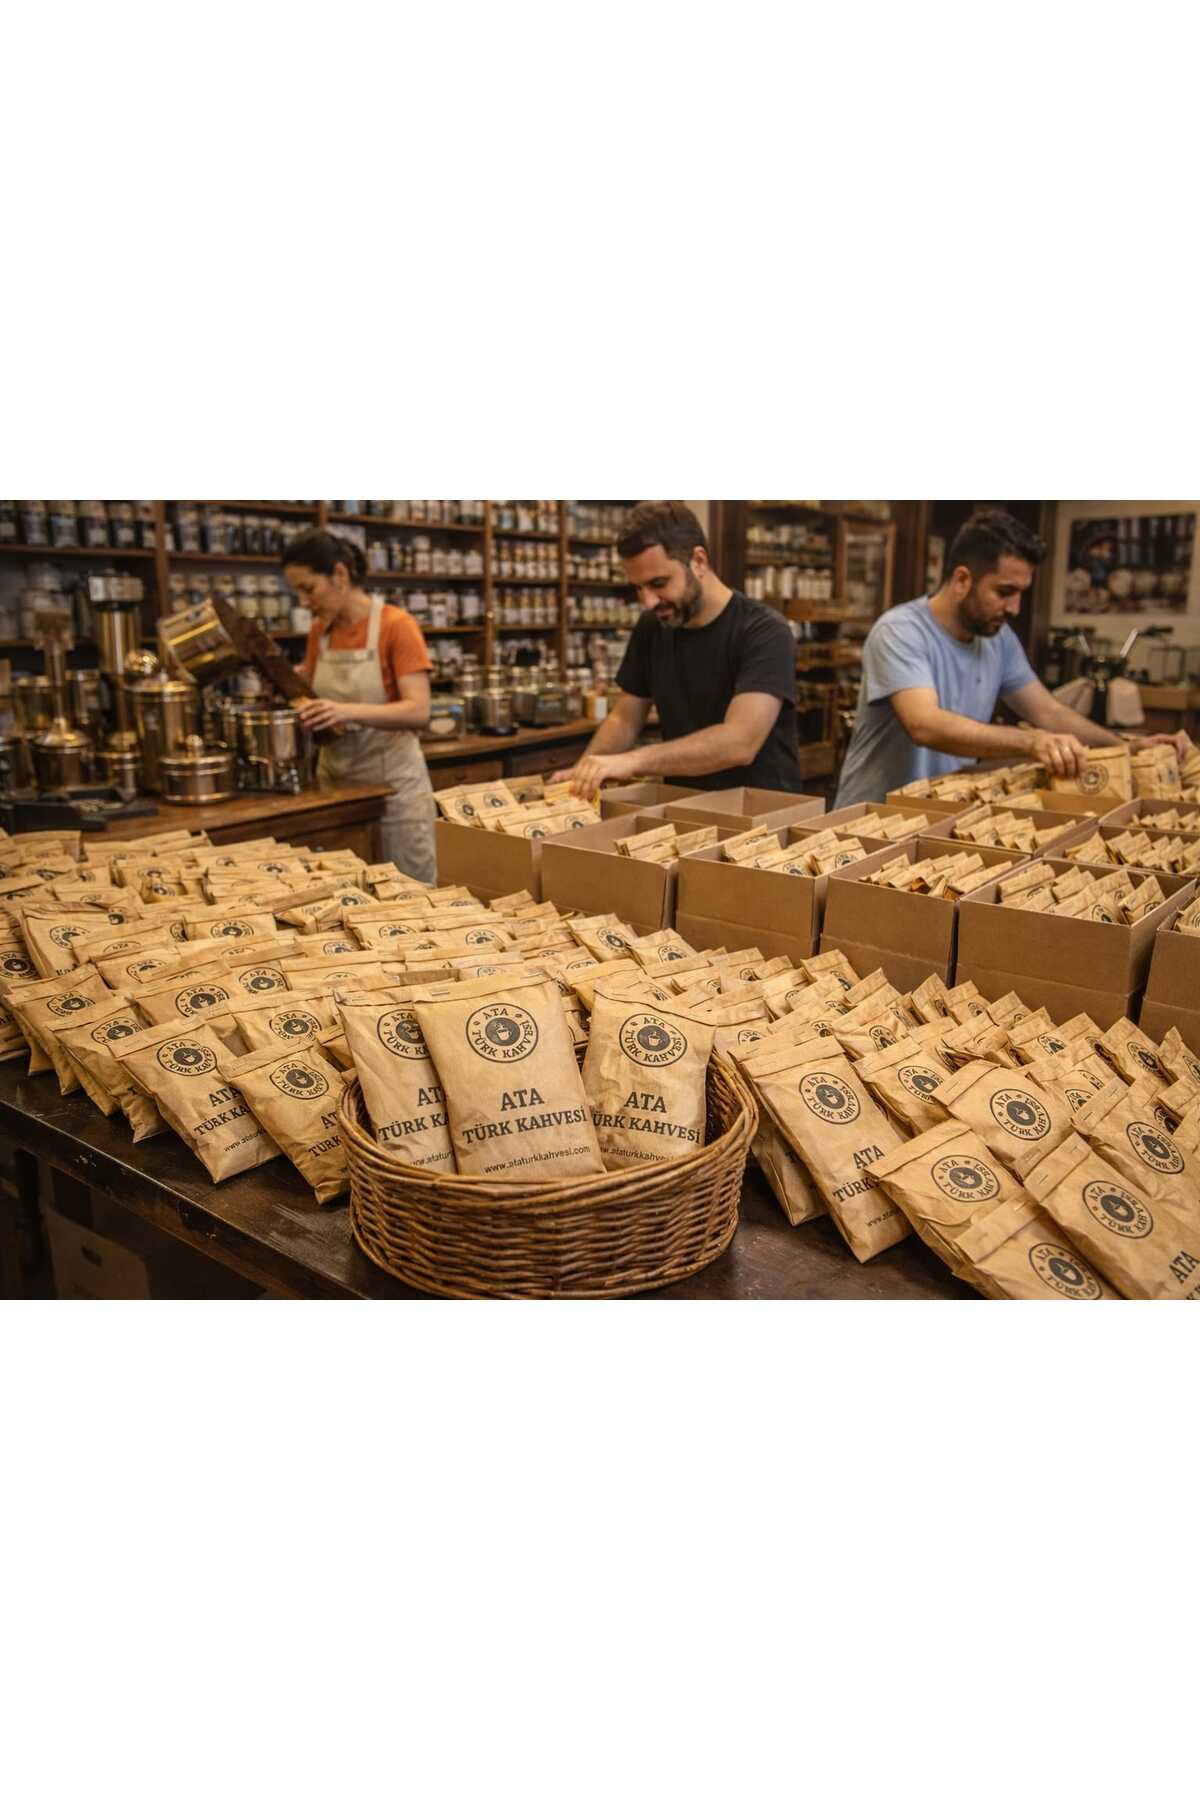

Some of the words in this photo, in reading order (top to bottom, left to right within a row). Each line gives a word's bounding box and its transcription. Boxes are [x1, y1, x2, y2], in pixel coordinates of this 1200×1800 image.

[482, 1008, 509, 1020] ATA
[208, 1086, 242, 1108] ATA
[416, 1086, 443, 1107] AT
[500, 1087, 545, 1112] ATA
[624, 1091, 668, 1114] ATA
[321, 1111, 337, 1130] AT
[378, 1117, 428, 1142] TÜRK
[462, 1120, 513, 1144] TÜRK
[515, 1105, 588, 1133] KAHVESİ
[591, 1111, 625, 1129] ÜRK
[628, 1117, 701, 1144] KAHVESİ
[853, 1145, 885, 1170] ATA
[1169, 1251, 1200, 1283] ATA
